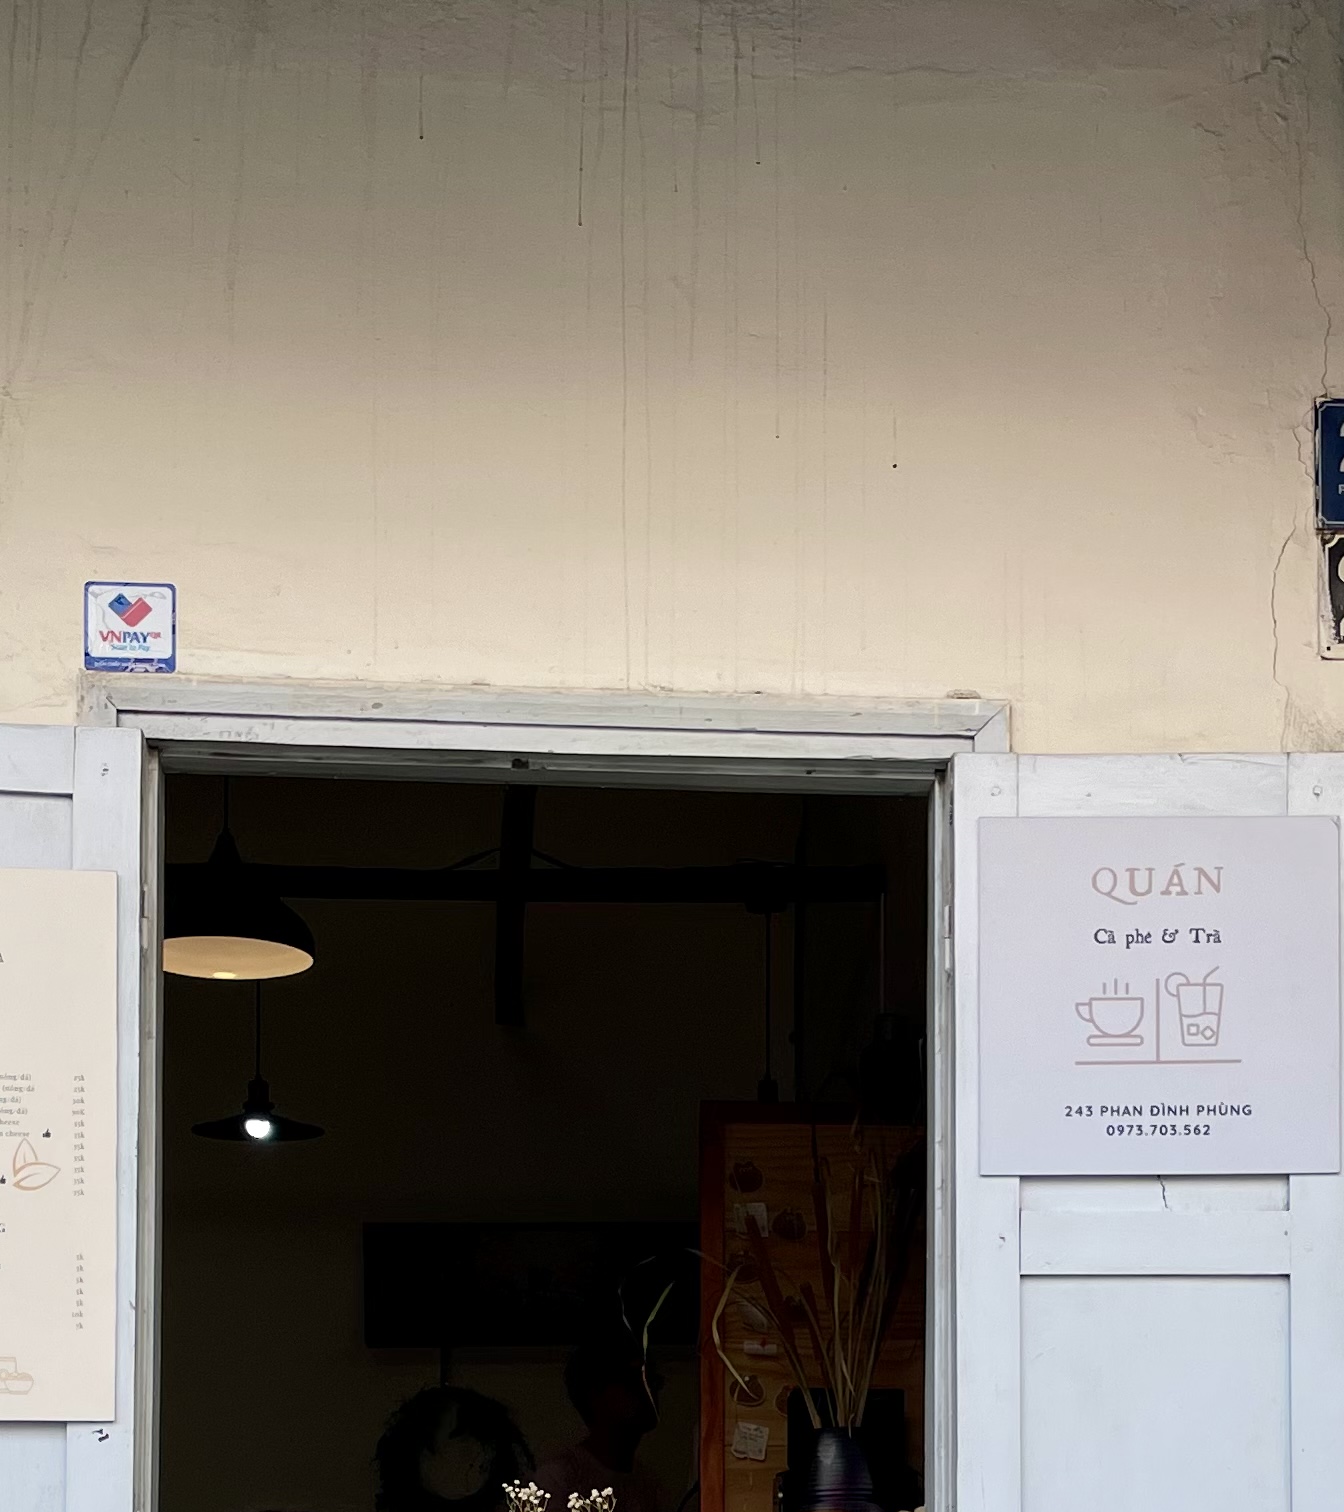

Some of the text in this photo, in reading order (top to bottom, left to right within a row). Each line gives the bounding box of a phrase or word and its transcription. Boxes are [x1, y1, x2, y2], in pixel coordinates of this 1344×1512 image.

[99, 630, 150, 643] VNPAY
[1091, 863, 1224, 905] QUÁN
[1162, 928, 1179, 944] &
[1064, 1104, 1093, 1117] 243
[1100, 1104, 1143, 1117] PHAN
[1196, 1102, 1252, 1117] PHÙNG
[1106, 1124, 1211, 1136] 0973.703.562
